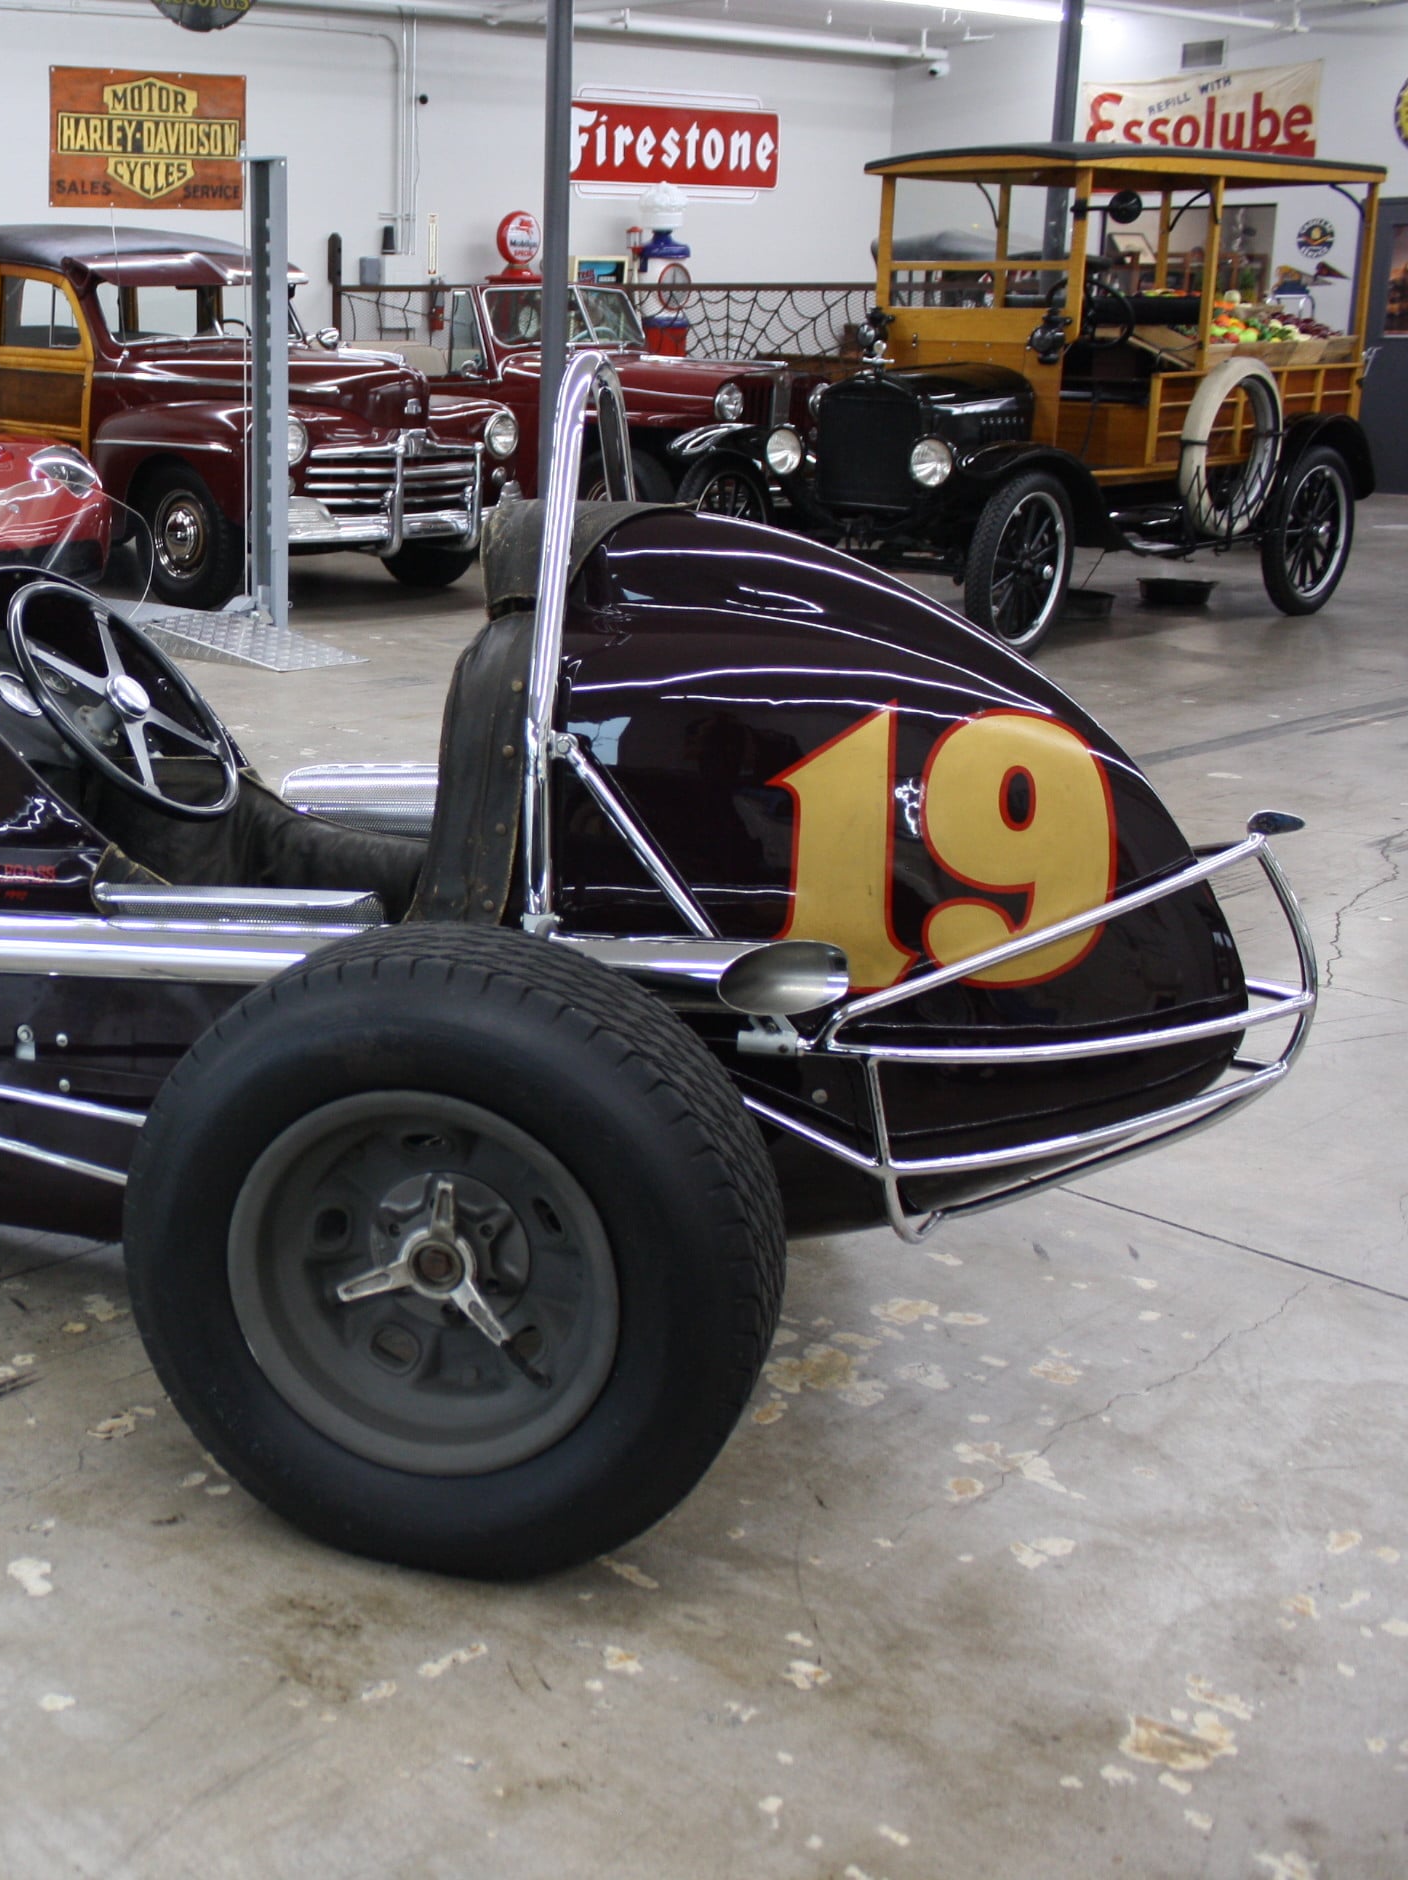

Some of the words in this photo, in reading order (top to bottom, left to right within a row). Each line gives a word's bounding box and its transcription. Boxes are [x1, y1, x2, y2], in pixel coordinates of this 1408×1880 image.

[111, 81, 188, 114] MOTOR
[1147, 92, 1191, 116] REFILL
[1198, 76, 1232, 95] WITH
[62, 117, 237, 156] HARLEY-DAVIDSON
[570, 106, 776, 173] Firestone
[1086, 92, 1313, 149] Essolube
[56, 179, 112, 196] SALES
[113, 160, 188, 194] CYCLES
[184, 184, 240, 199] SERVICE
[765, 698, 1117, 995] 19
